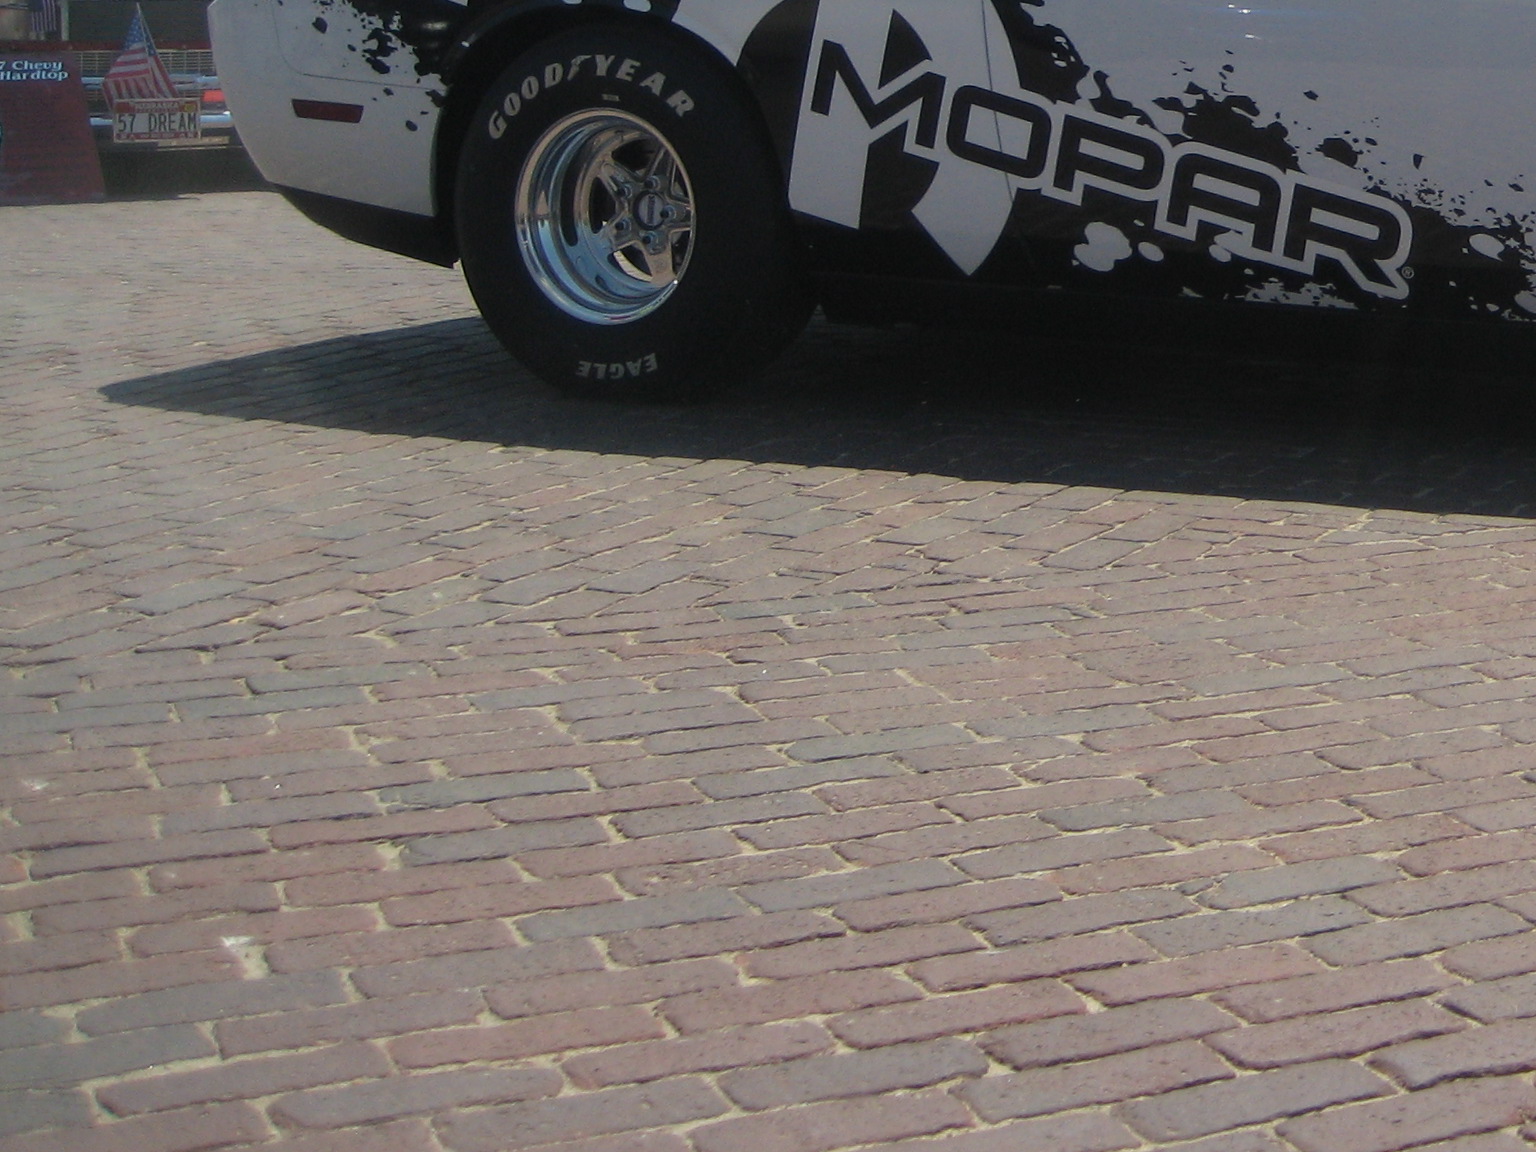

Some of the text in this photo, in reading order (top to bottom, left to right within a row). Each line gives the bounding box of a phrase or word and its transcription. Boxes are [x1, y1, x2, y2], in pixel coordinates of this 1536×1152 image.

[0, 70, 68, 81] Hardtop
[12, 60, 62, 71] Chevy
[488, 54, 695, 140] GOODYEAR
[118, 112, 197, 133] 57 DREAM
[807, 38, 1413, 300] MOPAR
[575, 353, 658, 380] EAGLE
